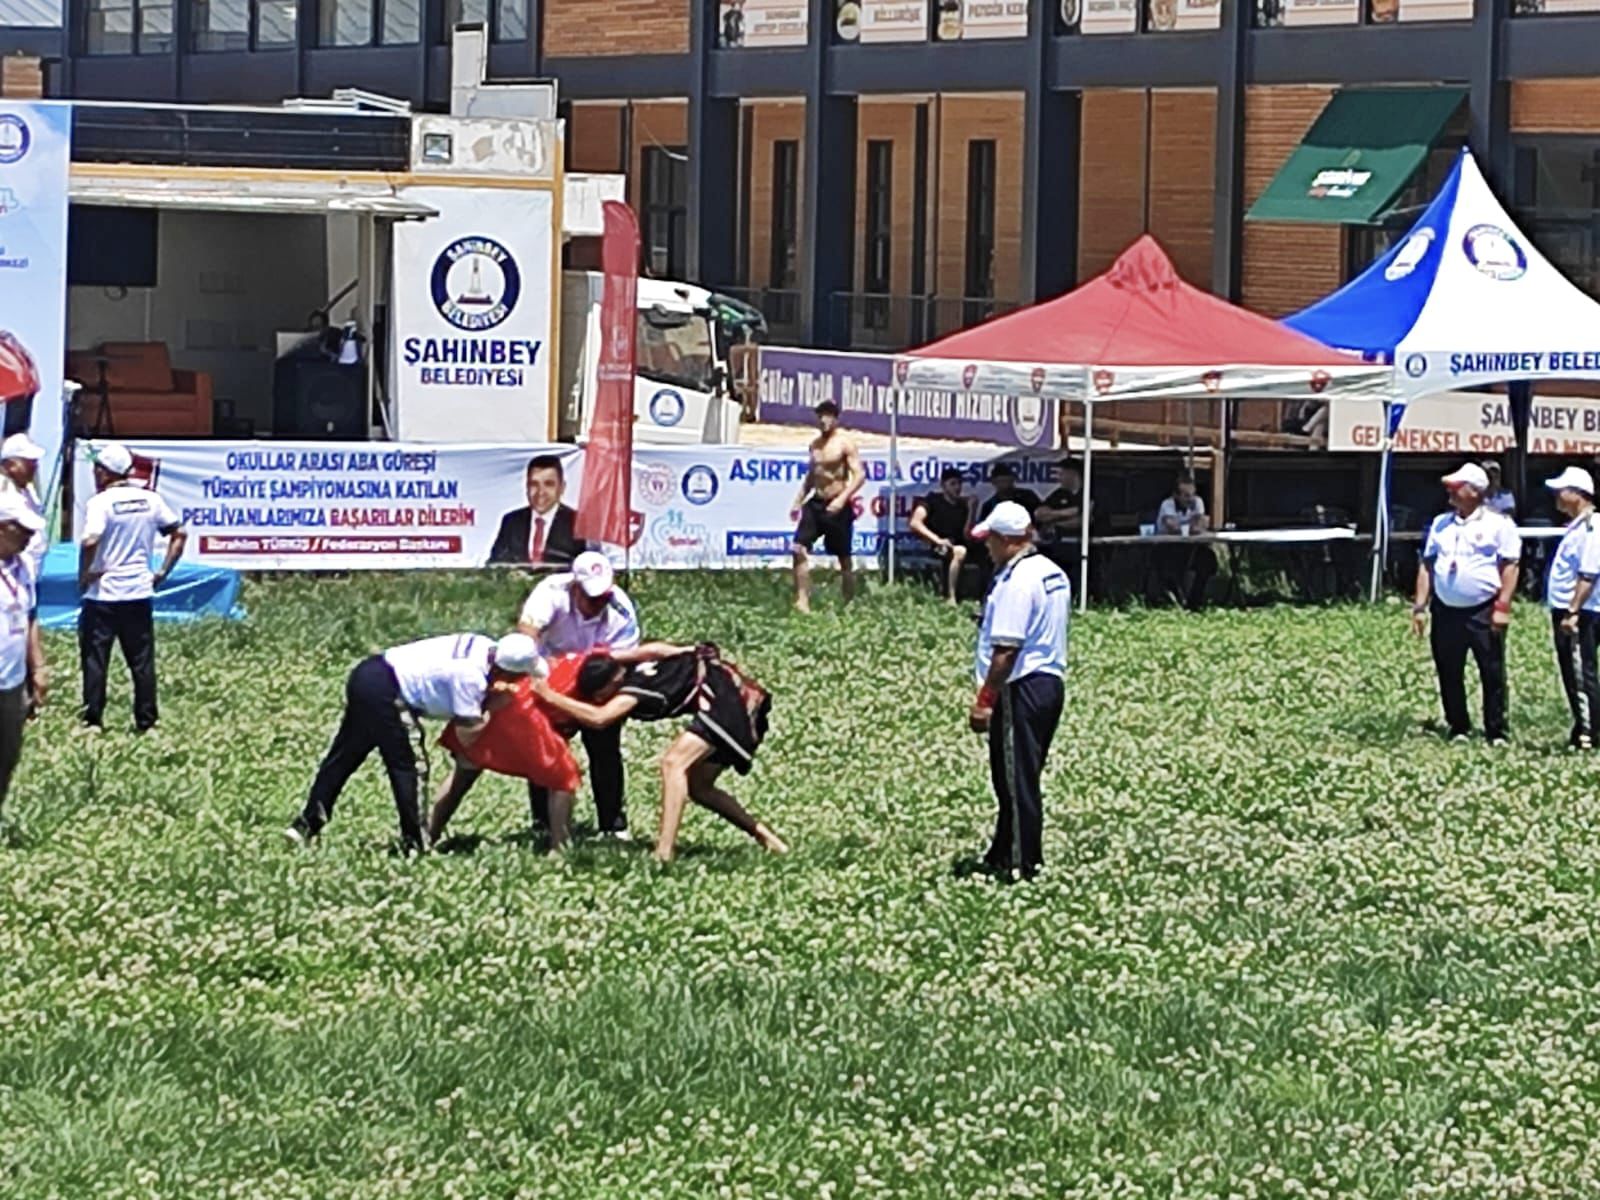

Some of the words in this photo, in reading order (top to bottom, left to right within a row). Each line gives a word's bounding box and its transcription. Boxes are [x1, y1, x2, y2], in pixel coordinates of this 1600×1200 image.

[404, 337, 541, 366] ŞAHİNBEY
[1482, 403, 1577, 430] ŞANBEY
[1352, 425, 1460, 452] GELNEKSEL
[226, 452, 296, 472] OKULLAR
[299, 451, 344, 471] ARASI
[347, 451, 380, 471] ABA
[729, 459, 811, 486] AŞIRT
[202, 475, 266, 499] TÜRKİYE
[395, 479, 458, 499] KATILAN
